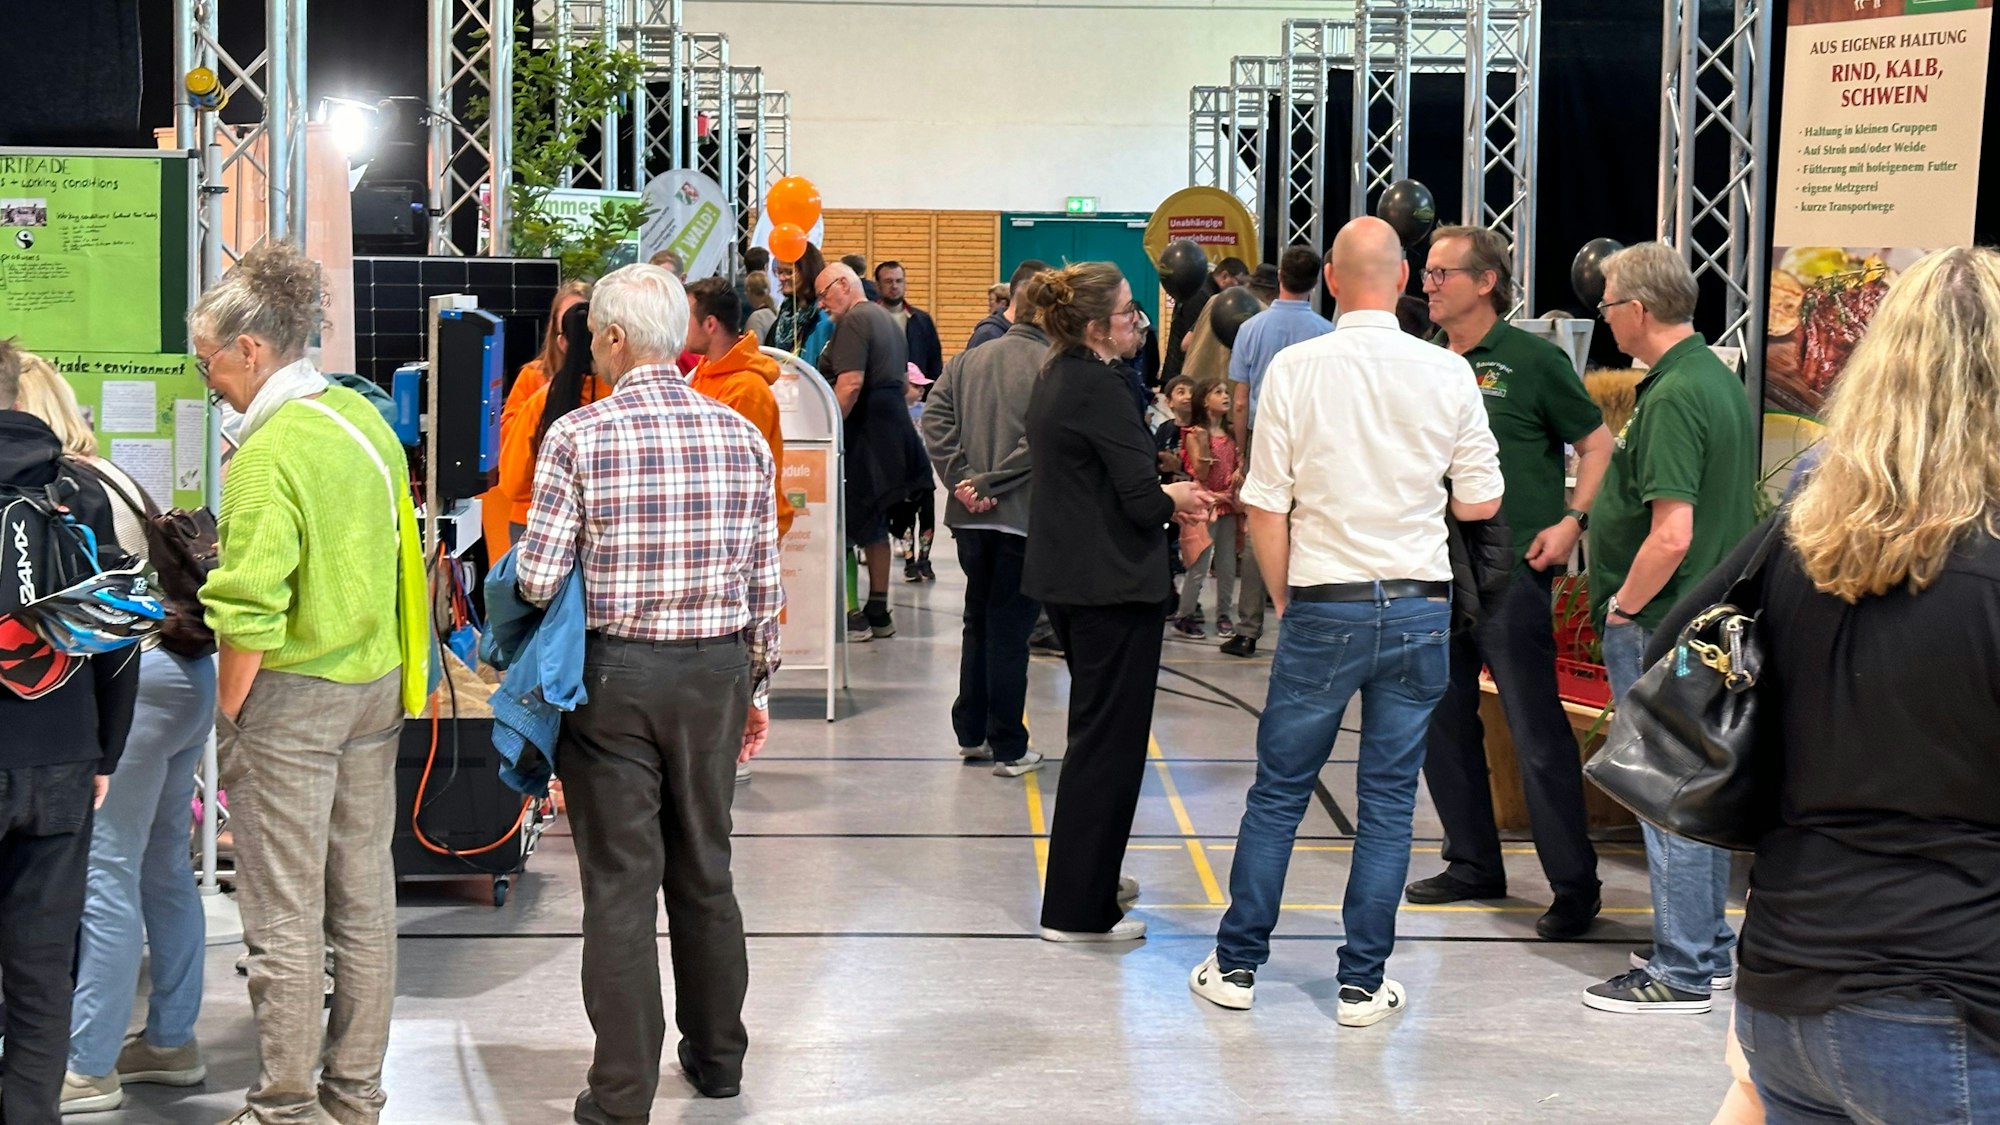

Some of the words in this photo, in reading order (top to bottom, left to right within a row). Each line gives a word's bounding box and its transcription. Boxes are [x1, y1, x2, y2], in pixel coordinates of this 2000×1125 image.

[1810, 40, 1838, 55] AUS
[1841, 35, 1896, 53] EIGENER
[1900, 29, 1967, 48] HALTUNG
[1832, 61, 1881, 83] RIND,
[1886, 57, 1944, 79] KALB,
[1841, 84, 1929, 107] SCHWEIN
[1804, 125, 1842, 138] Haltung
[1844, 125, 1853, 135] in
[1855, 123, 1889, 135] kleinen
[1891, 122, 1938, 136] Gruppen
[1803, 145, 1821, 155] Auf
[1823, 144, 1847, 155] Stroh
[1849, 142, 1892, 154] und/oder
[1894, 141, 1926, 152] Weide
[1803, 163, 1847, 176] Fütterung
[1849, 162, 1864, 173] mit
[1866, 161, 1924, 175] hofeigenem
[1927, 161, 1958, 172] Futter
[21, 178, 57, 193] working
[63, 177, 119, 190] conditions
[1802, 183, 1833, 196] eigene
[1834, 181, 1879, 195] Metzgerei
[542, 199, 598, 215] mmes
[1801, 201, 1827, 212] kurze
[1829, 201, 1895, 214] Transportwege
[681, 206, 717, 249] WALD!
[1169, 217, 1223, 228] Unabhängige
[54, 355, 90, 373] trade
[12, 519, 36, 604] 24MX
